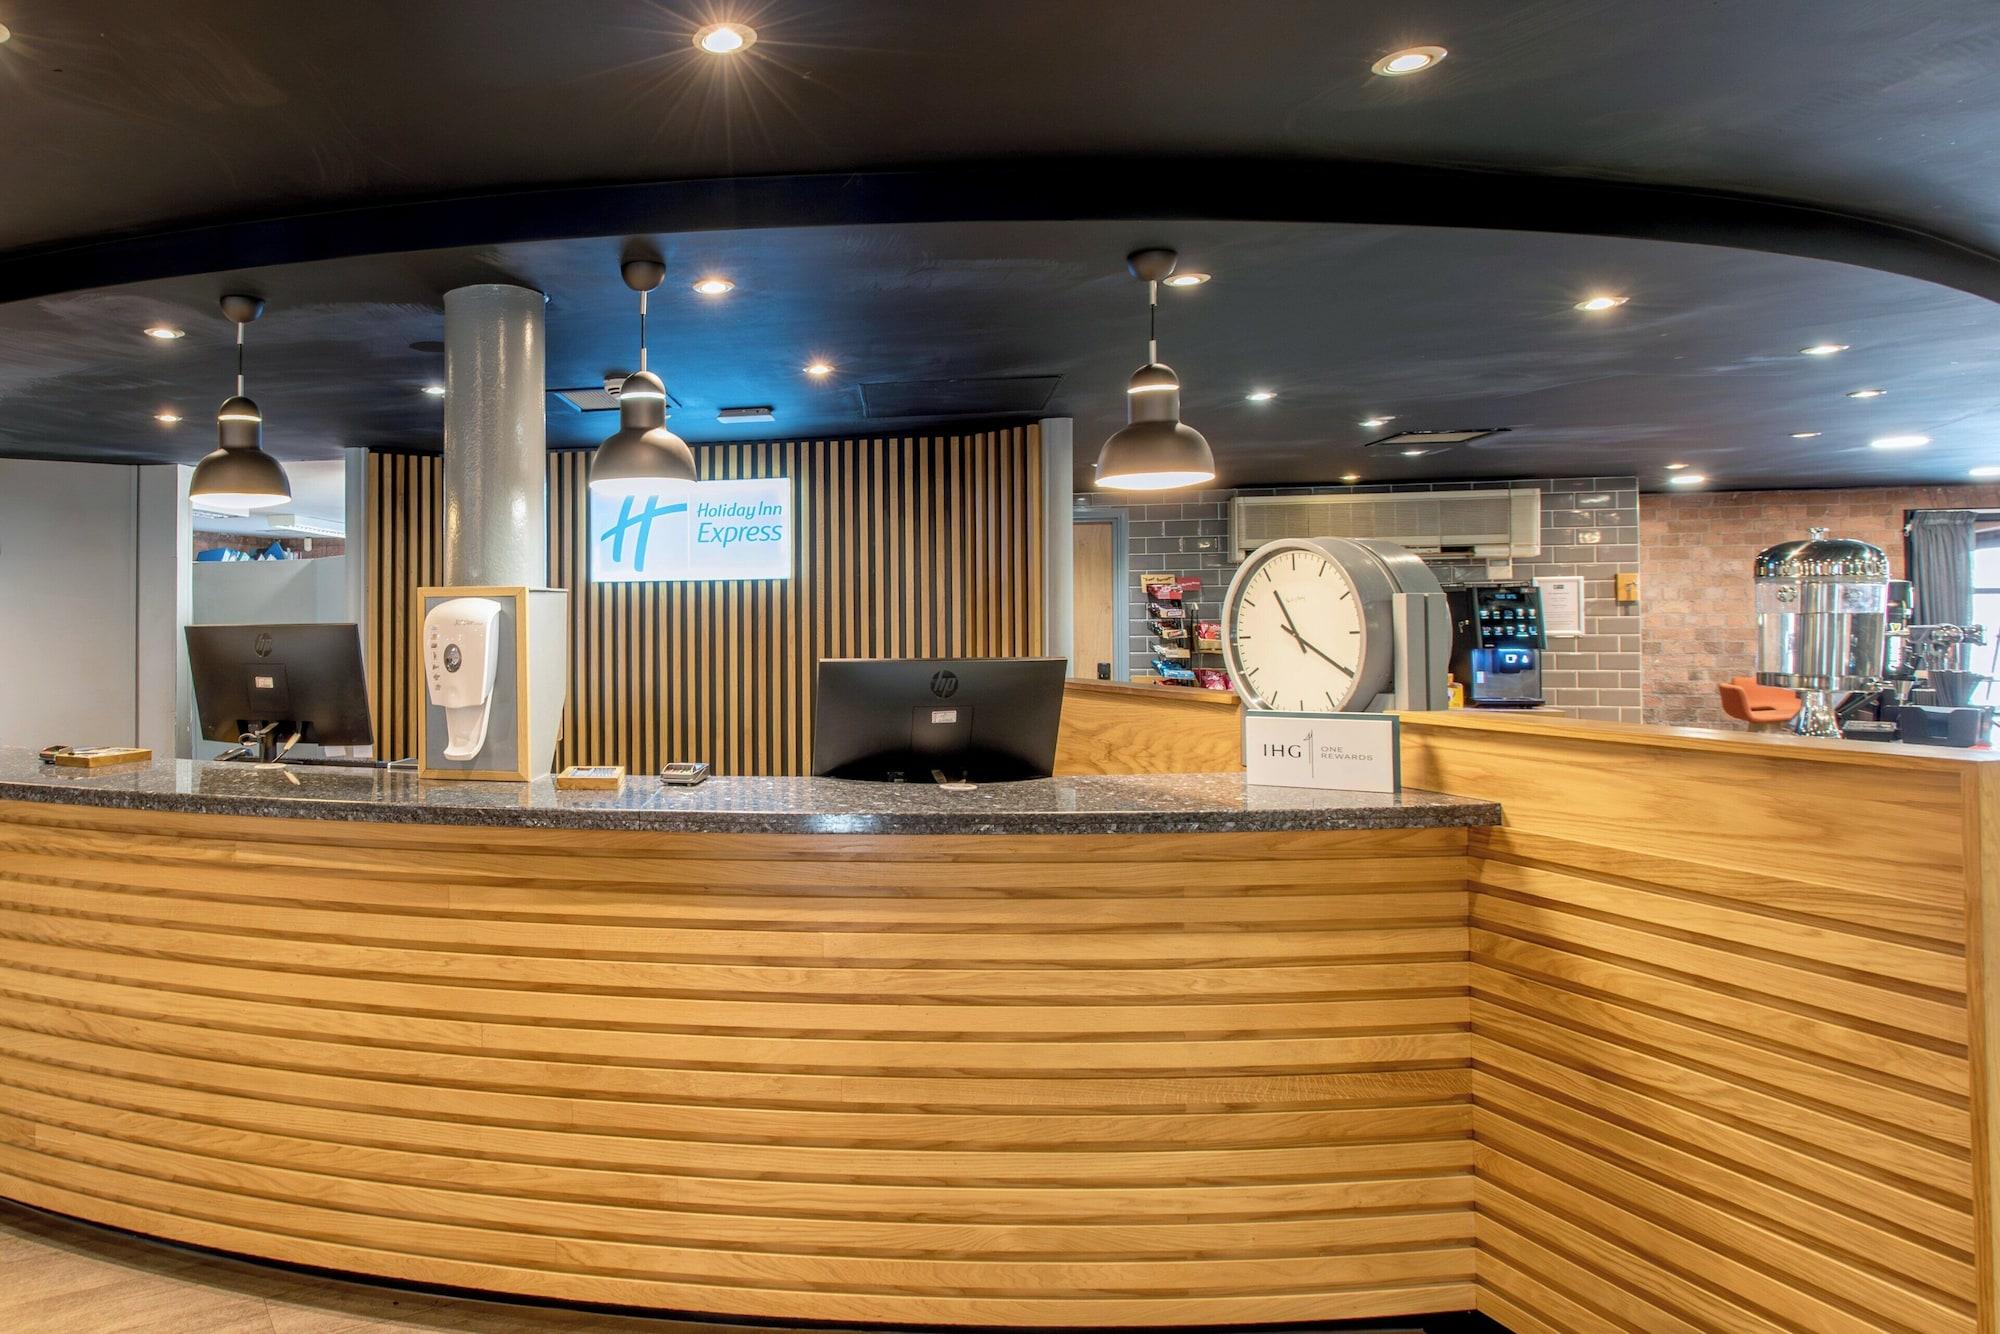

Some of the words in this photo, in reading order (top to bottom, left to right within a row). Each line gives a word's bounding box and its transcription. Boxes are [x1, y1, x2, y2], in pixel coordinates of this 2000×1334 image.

[697, 502, 756, 519] Holiday
[758, 500, 782, 516] Inn
[697, 522, 783, 548] Express
[1263, 743, 1301, 758] IHG
[1320, 753, 1374, 761] REWARDS
